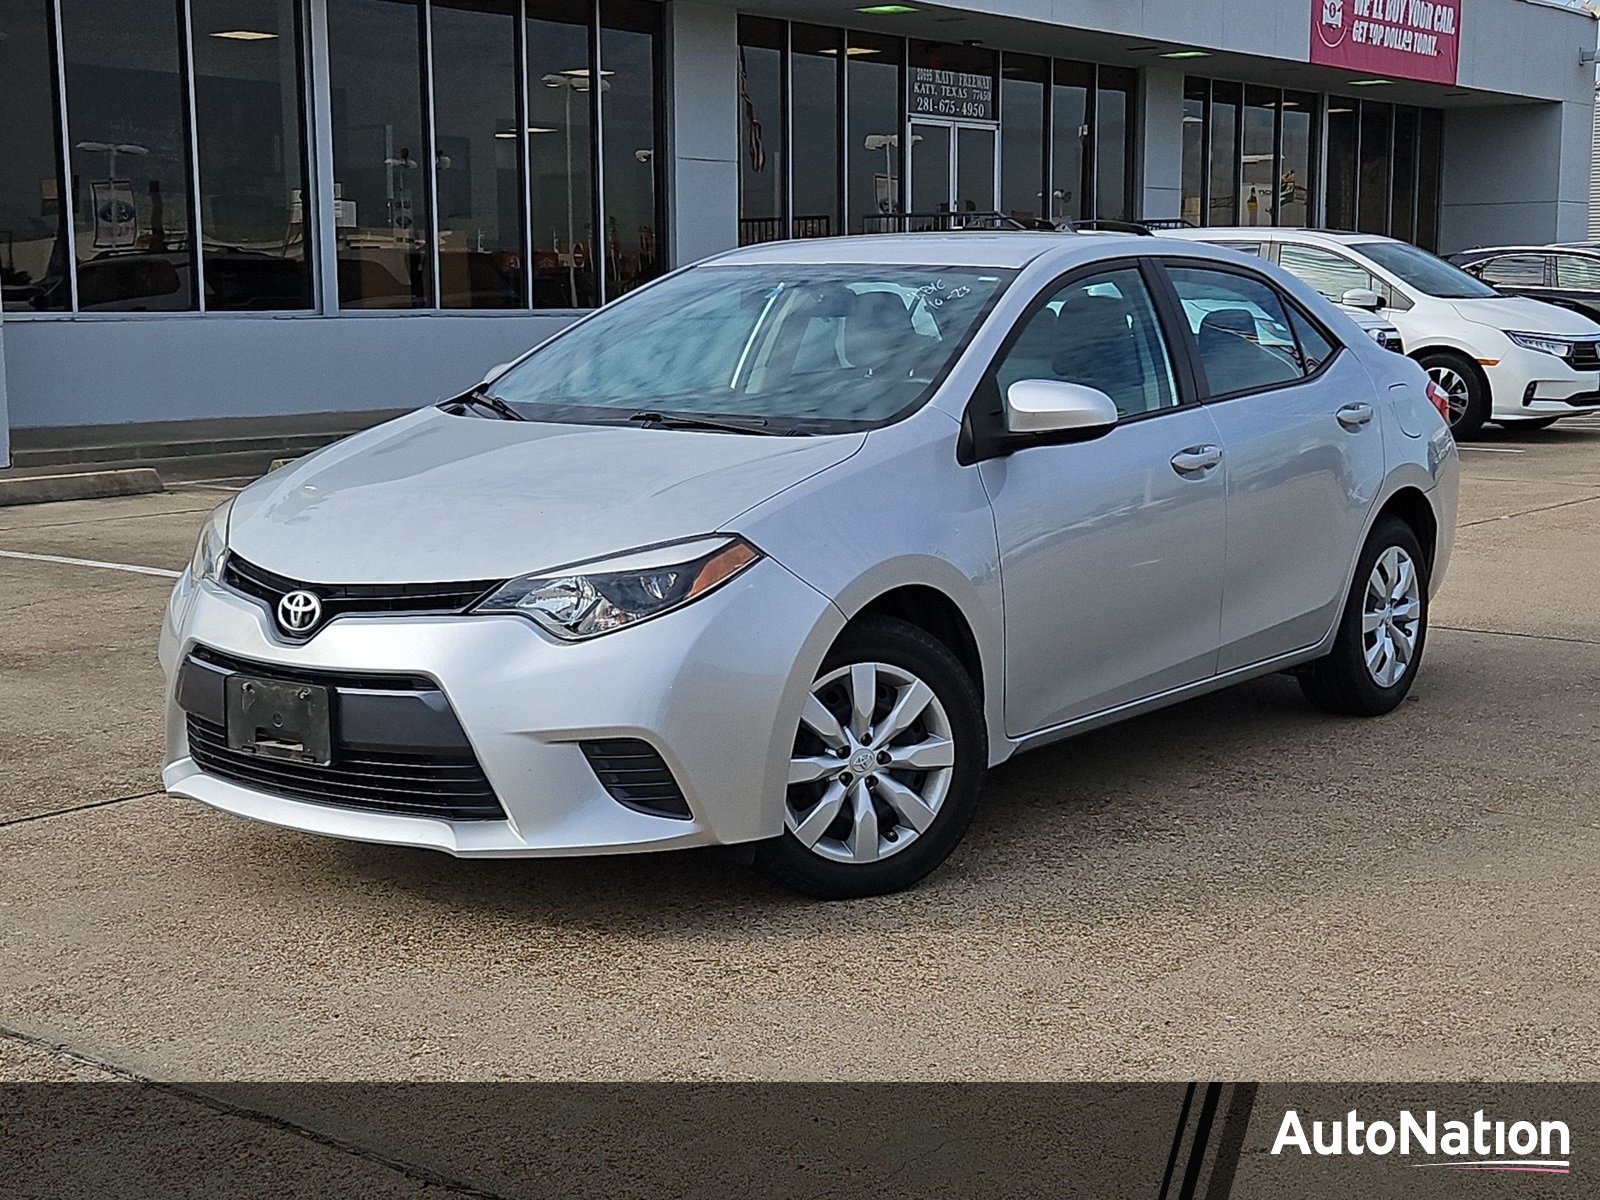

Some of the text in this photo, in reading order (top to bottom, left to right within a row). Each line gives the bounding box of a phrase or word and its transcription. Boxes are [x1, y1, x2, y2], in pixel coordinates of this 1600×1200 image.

[1385, 0, 1407, 24] BUY
[1408, 0, 1433, 30] YOUR
[1352, 20, 1437, 57] GET TOP DOLLAR TODAY.
[941, 86, 968, 98] TEXAS
